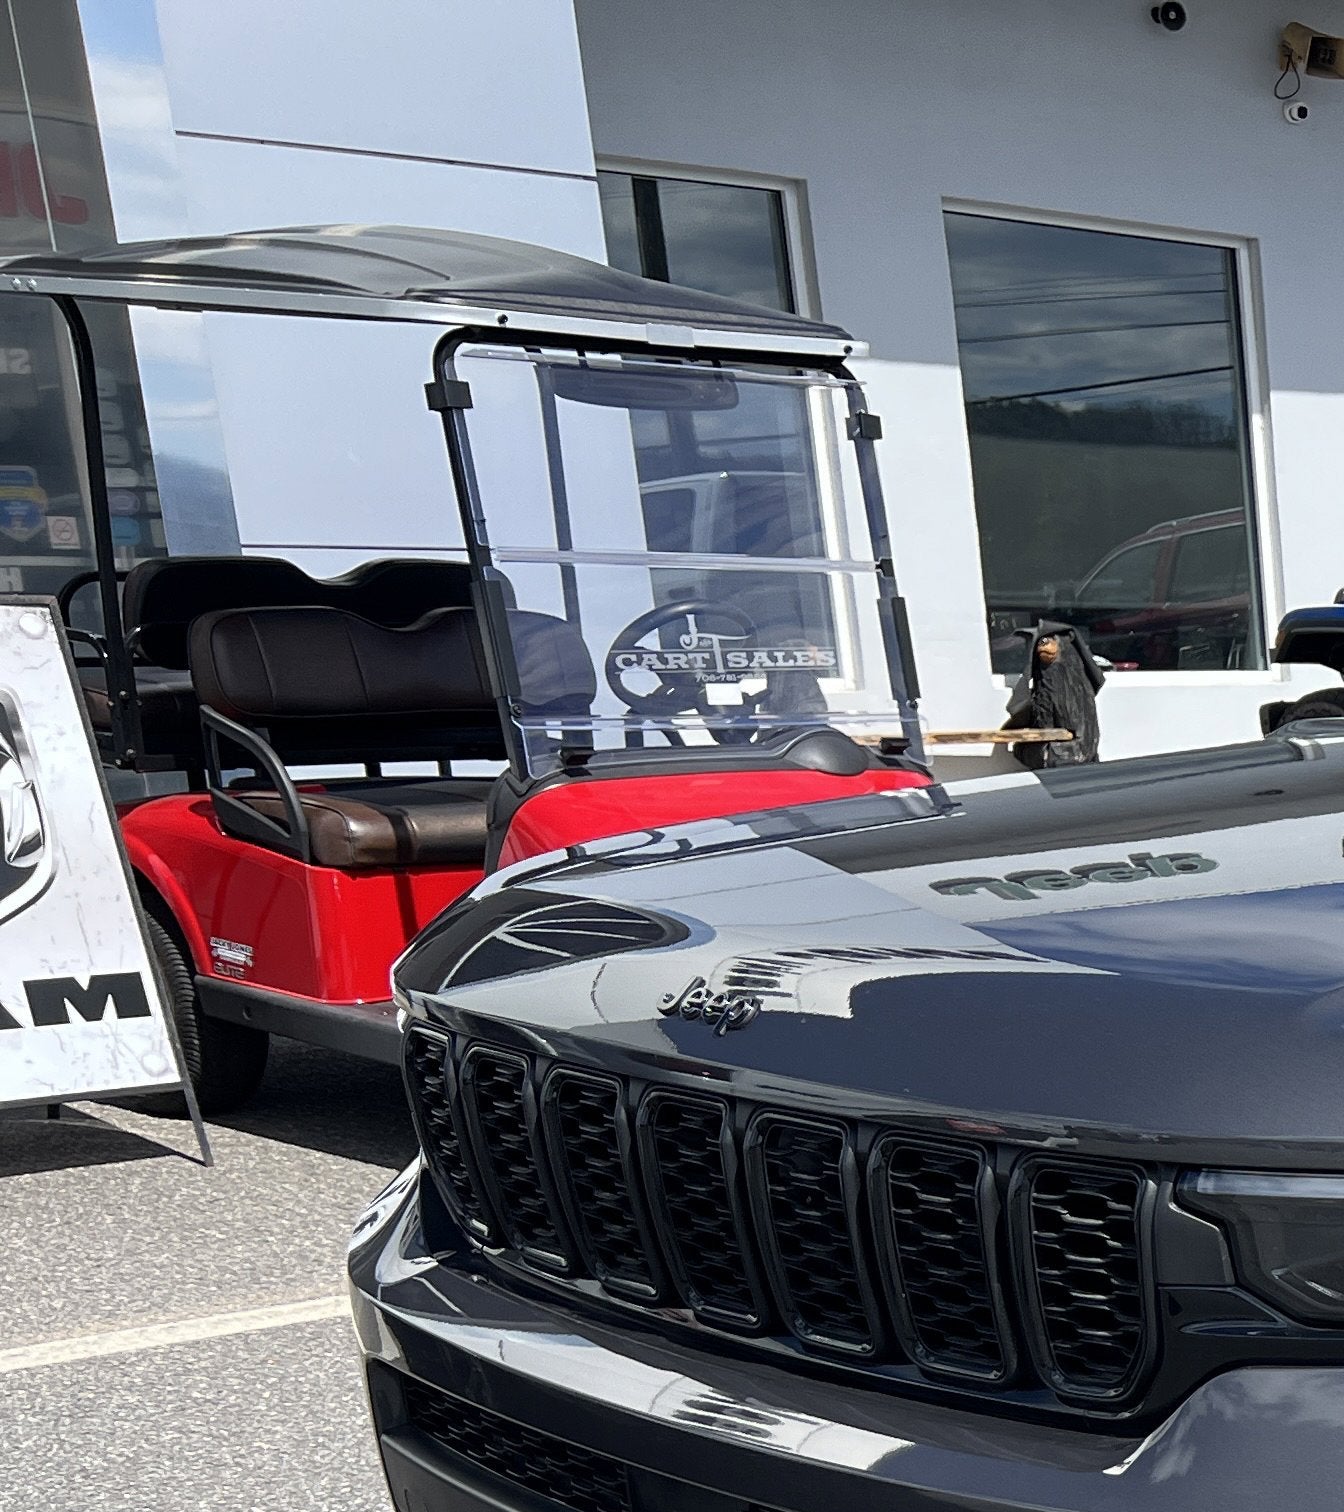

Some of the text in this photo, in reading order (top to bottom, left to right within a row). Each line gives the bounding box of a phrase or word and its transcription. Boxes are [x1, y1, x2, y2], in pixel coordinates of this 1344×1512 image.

[615, 651, 837, 670] CART SALES
[0, 971, 151, 1031] M
[657, 976, 762, 1036] Jeep
